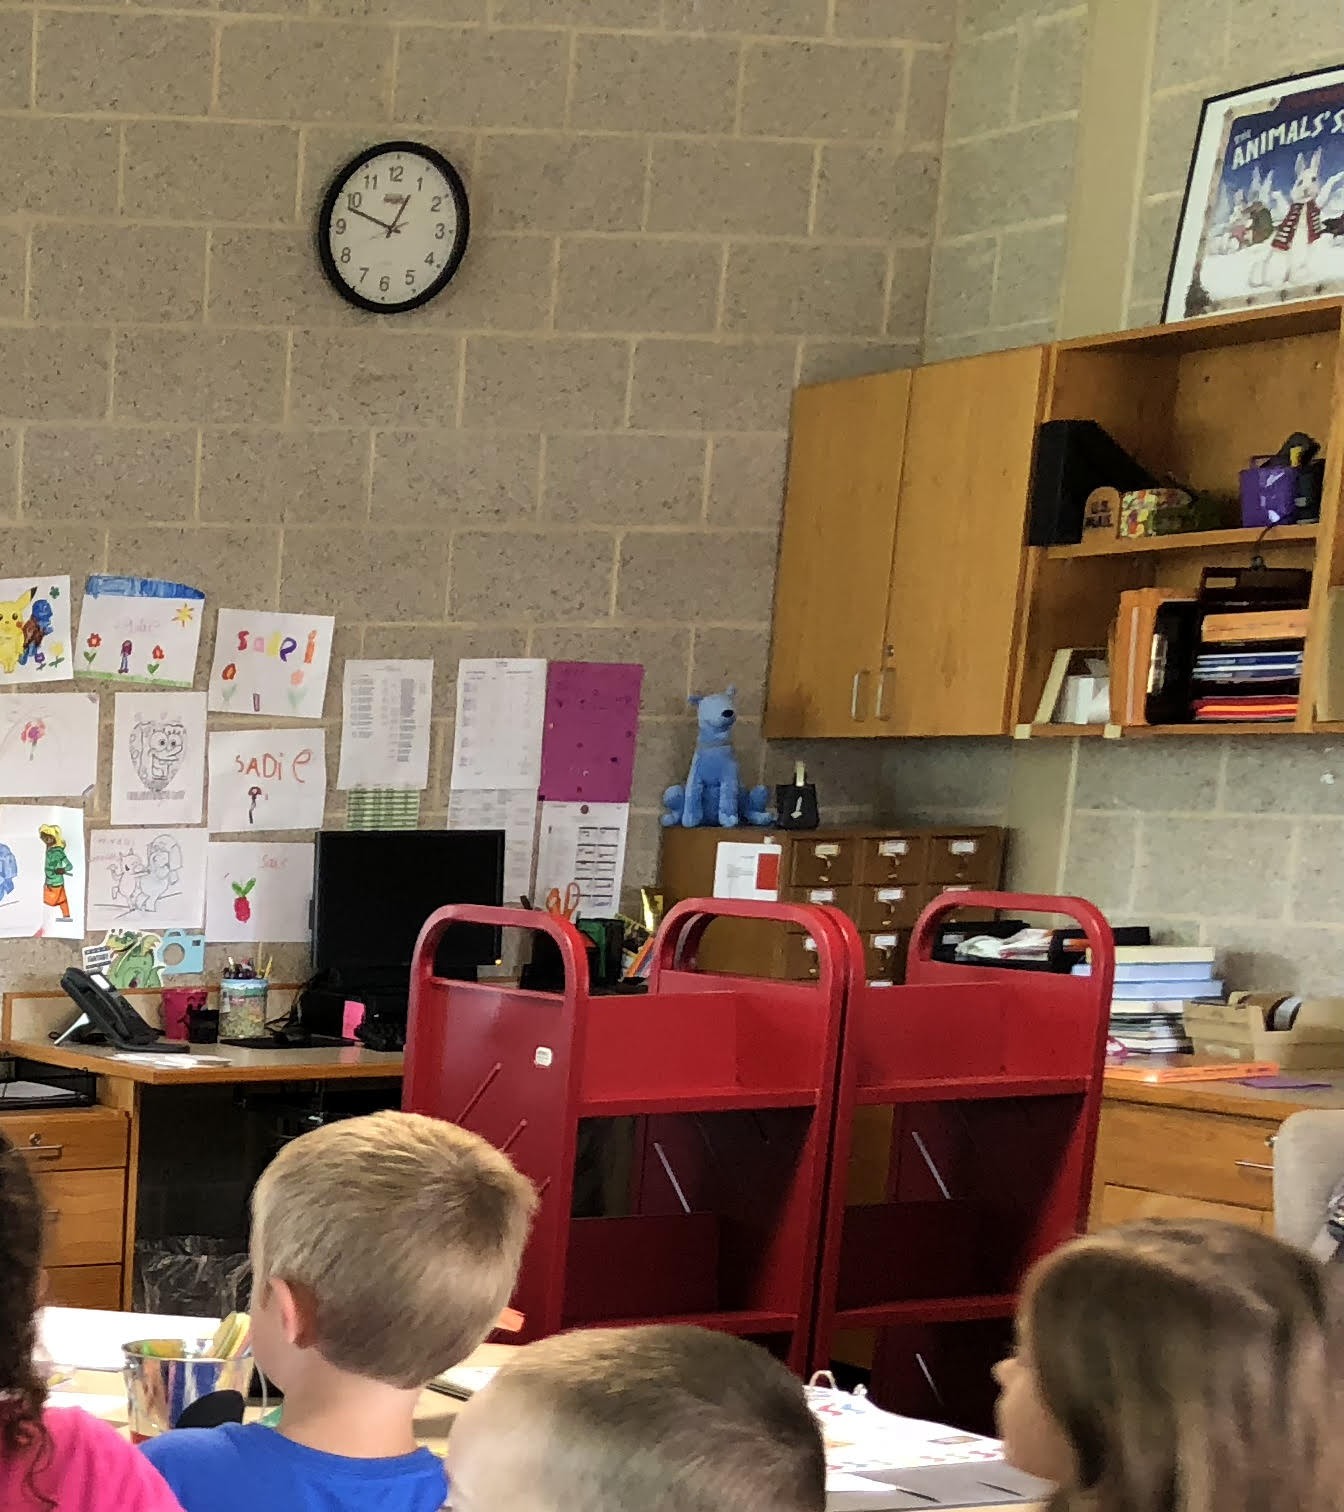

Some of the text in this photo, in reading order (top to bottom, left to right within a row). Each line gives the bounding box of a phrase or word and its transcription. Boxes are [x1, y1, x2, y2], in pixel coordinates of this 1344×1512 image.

[389, 166, 404, 182] 12
[364, 175, 378, 190] 11
[416, 177, 423, 192] 1
[348, 192, 362, 208] 10
[430, 196, 442, 212] 2
[335, 218, 347, 235] 9
[434, 223, 445, 239] 3
[341, 247, 352, 263] 8
[424, 252, 434, 265] 4
[359, 267, 370, 283] 7
[405, 270, 416, 285] 5
[379, 276, 390, 292] 6
